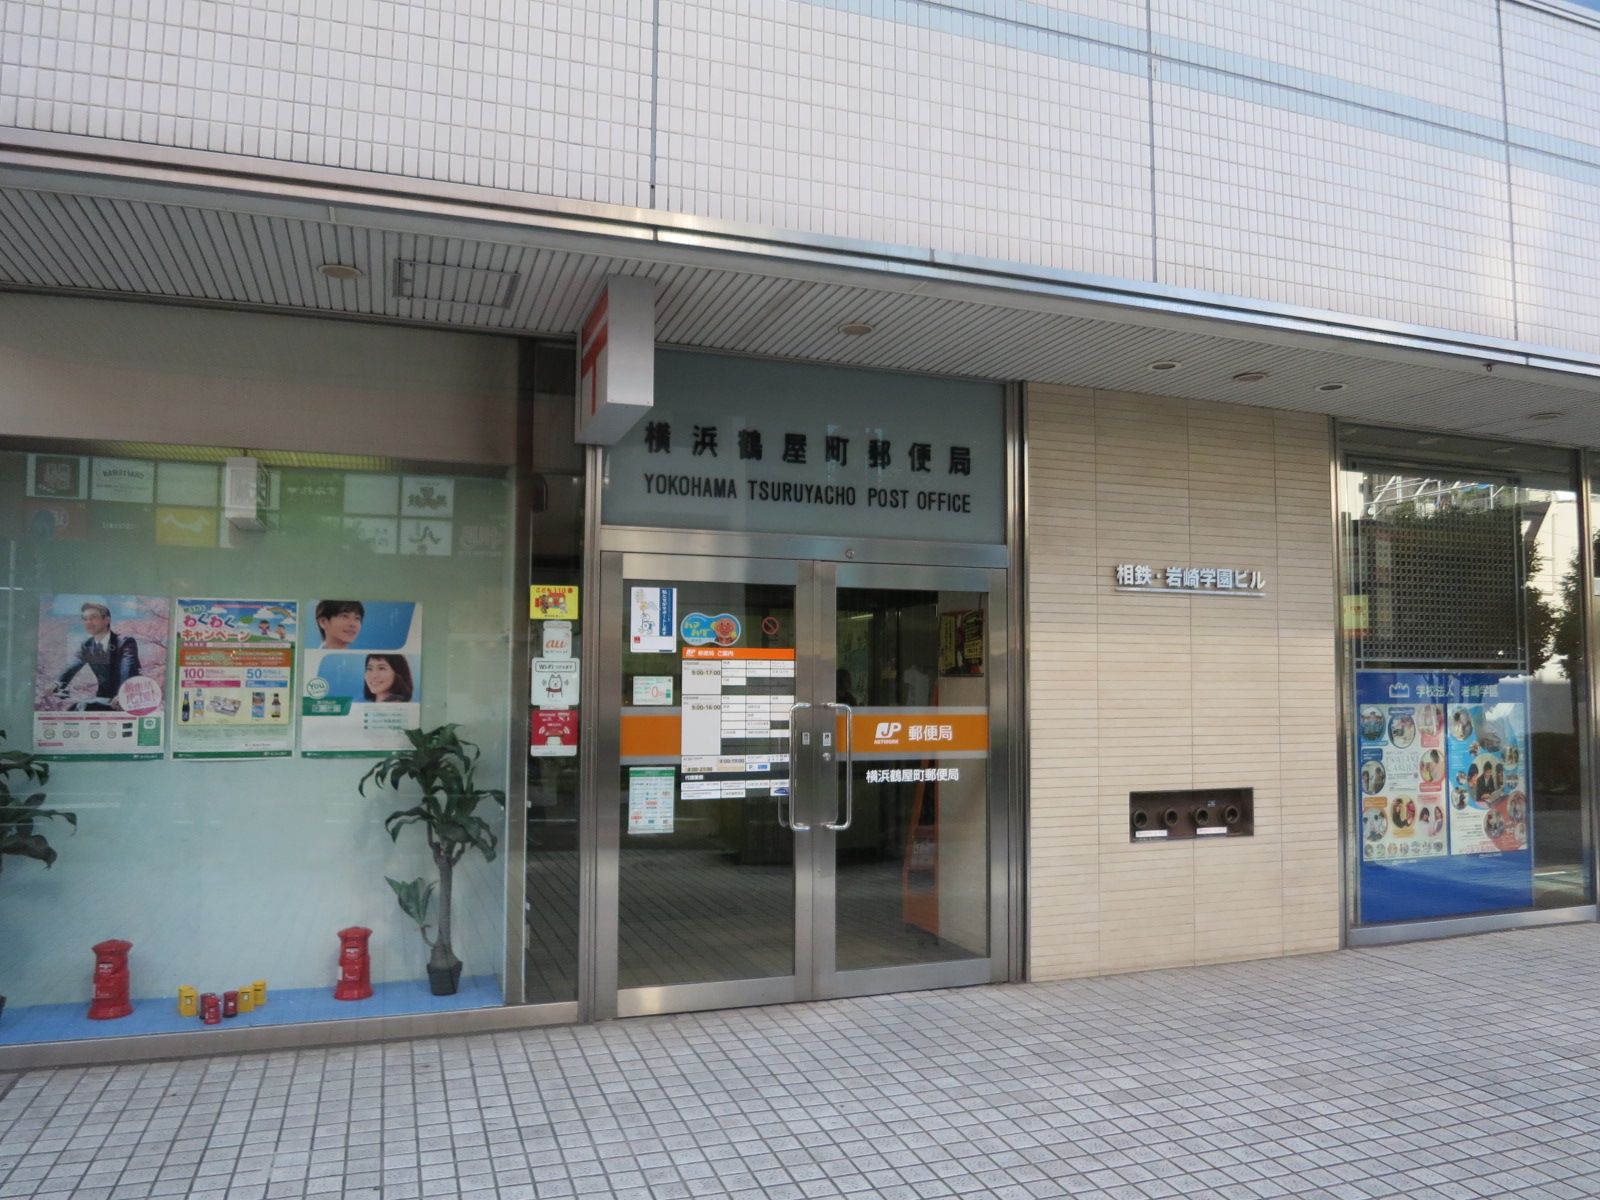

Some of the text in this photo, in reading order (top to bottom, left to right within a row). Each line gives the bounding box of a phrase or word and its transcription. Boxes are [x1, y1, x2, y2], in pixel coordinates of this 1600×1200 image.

[644, 420, 972, 476] 横浜鶴屋町郵便局
[643, 473, 972, 514] YOKOHAMA TSURUYACHO POST OFFICE
[1116, 563, 1267, 591] 相鉄・岩崎学園ビル
[183, 612, 236, 629] わくわく
[181, 628, 251, 642] キャンペーン
[545, 639, 567, 649] au
[183, 668, 205, 679] 100
[247, 668, 262, 679] 50
[908, 724, 953, 742] 郵便局
[865, 768, 959, 783] 横浜鶴屋町郵便局
